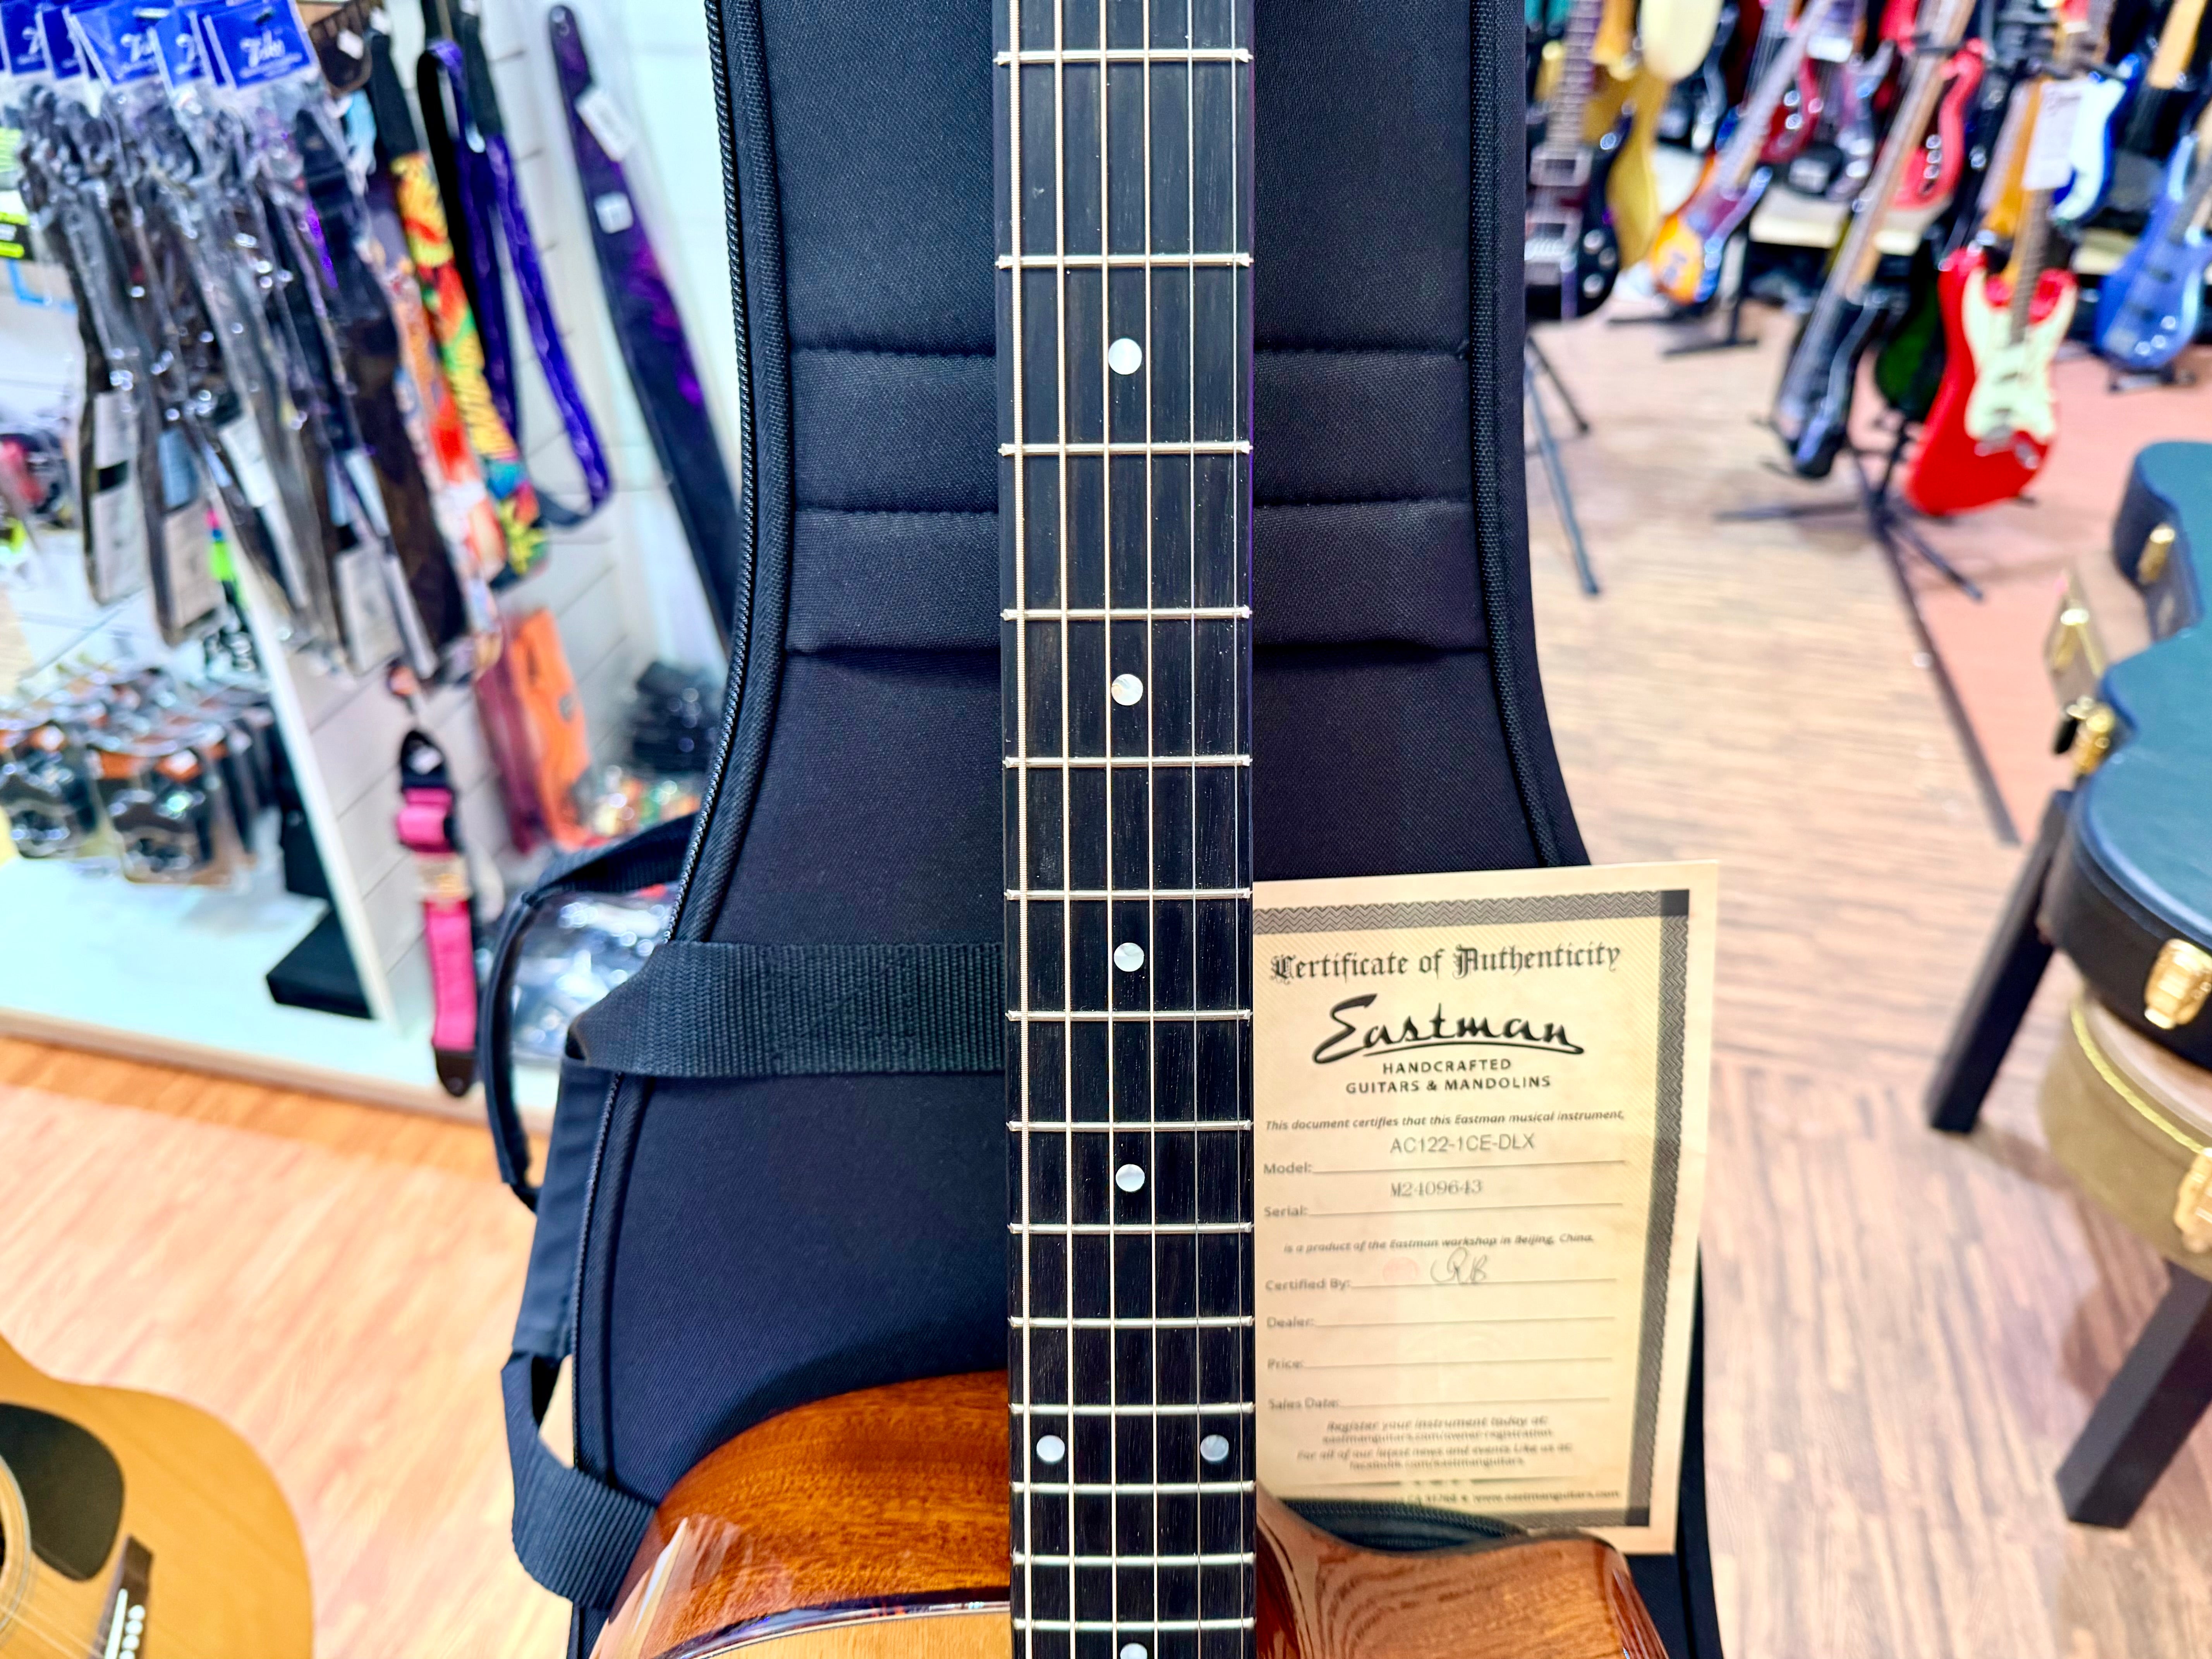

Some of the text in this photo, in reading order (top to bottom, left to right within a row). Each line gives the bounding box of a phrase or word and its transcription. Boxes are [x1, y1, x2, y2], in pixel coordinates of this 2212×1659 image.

[1270, 941, 1621, 984] Certificate of Authenticity
[1312, 994, 1583, 1064] Eastman
[1383, 1059, 1511, 1074] HANDCRAFTED
[1346, 1076, 1551, 1094] GUITARS & MANDOLINS
[1266, 1120, 1288, 1131] This
[1291, 1119, 1349, 1130] document
[1353, 1116, 1398, 1129] certifies
[1402, 1116, 1426, 1126] that
[1429, 1115, 1451, 1126] this
[1455, 1114, 1505, 1124] Eastman
[1509, 1111, 1554, 1123] musical
[1390, 1133, 1535, 1153] AC122-1CE-DLX
[1264, 1162, 1312, 1175] Model:
[1391, 1180, 1483, 1197] M2409643
[1264, 1206, 1308, 1217] Serial:
[1284, 1243, 1293, 1253] is
[1305, 1242, 1351, 1254] product
[1353, 1240, 1367, 1251] of
[1368, 1240, 1386, 1249] the
[1389, 1239, 1438, 1249] Eastman
[1442, 1237, 1497, 1247] workshop
[1500, 1235, 1511, 1244] in
[1265, 1279, 1326, 1291] Certified
